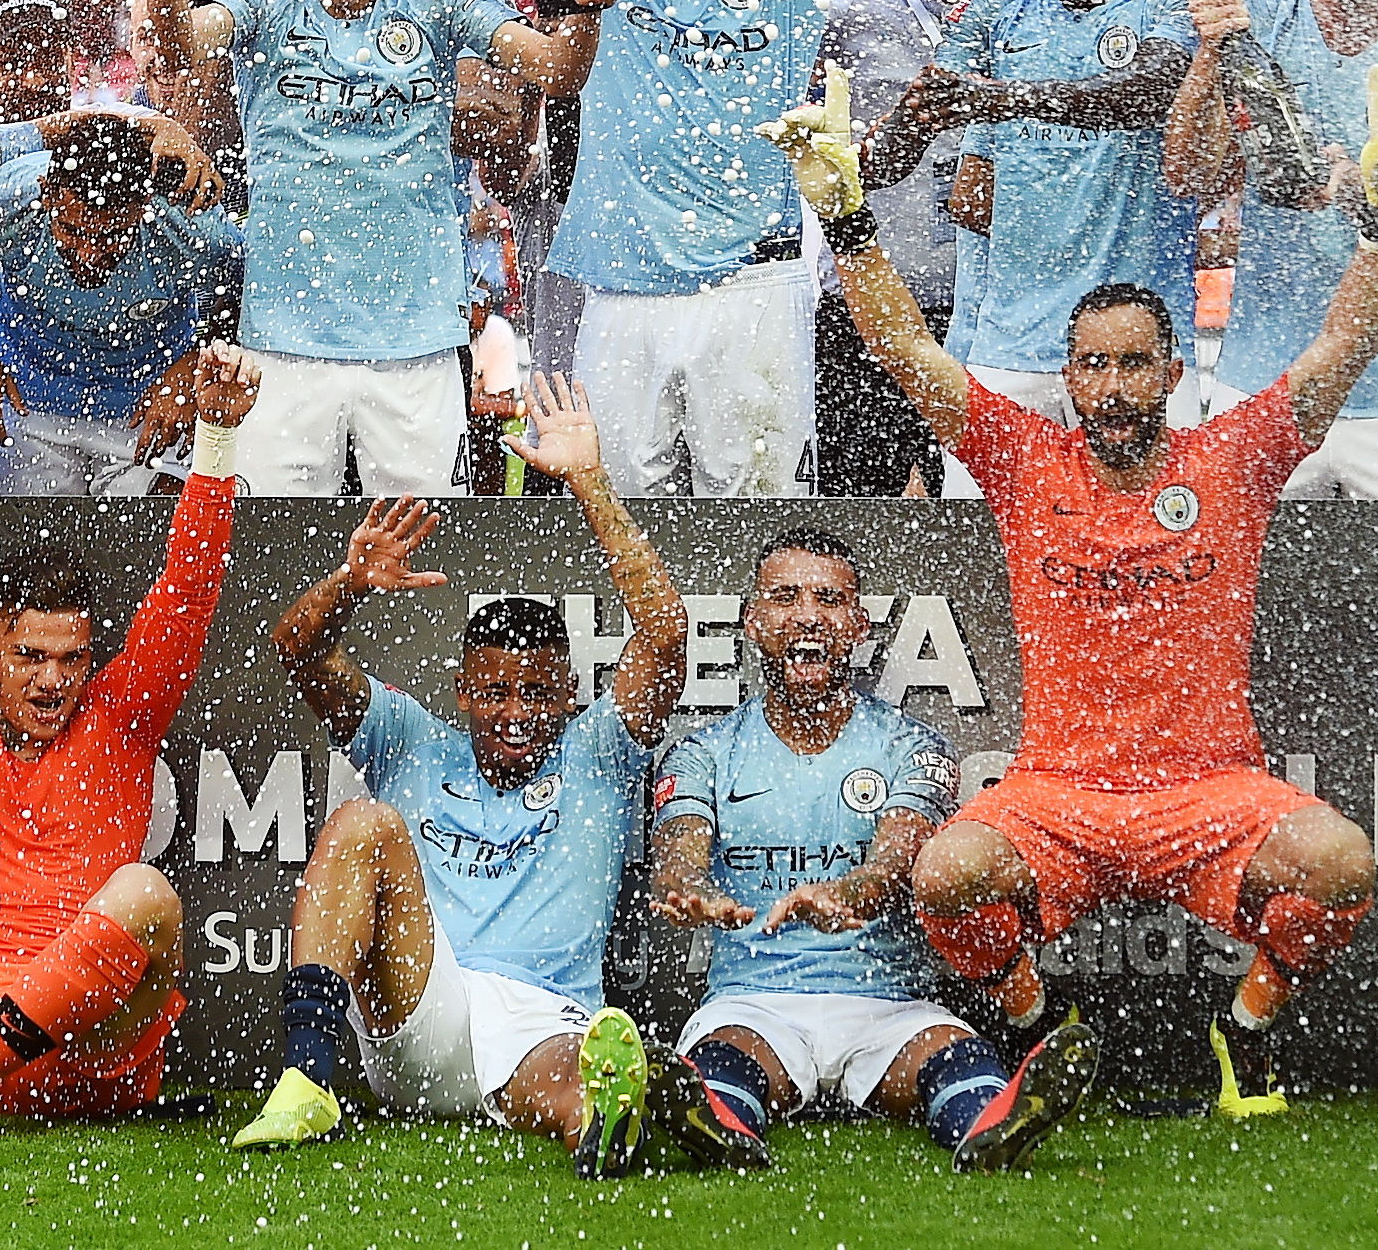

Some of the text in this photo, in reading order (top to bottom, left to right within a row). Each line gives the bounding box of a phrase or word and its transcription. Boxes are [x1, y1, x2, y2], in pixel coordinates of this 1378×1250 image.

[277, 73, 438, 108] ETIHAD
[305, 106, 410, 126] AIRWAYS
[469, 594, 741, 706] HE
[204, 910, 293, 974] Su
